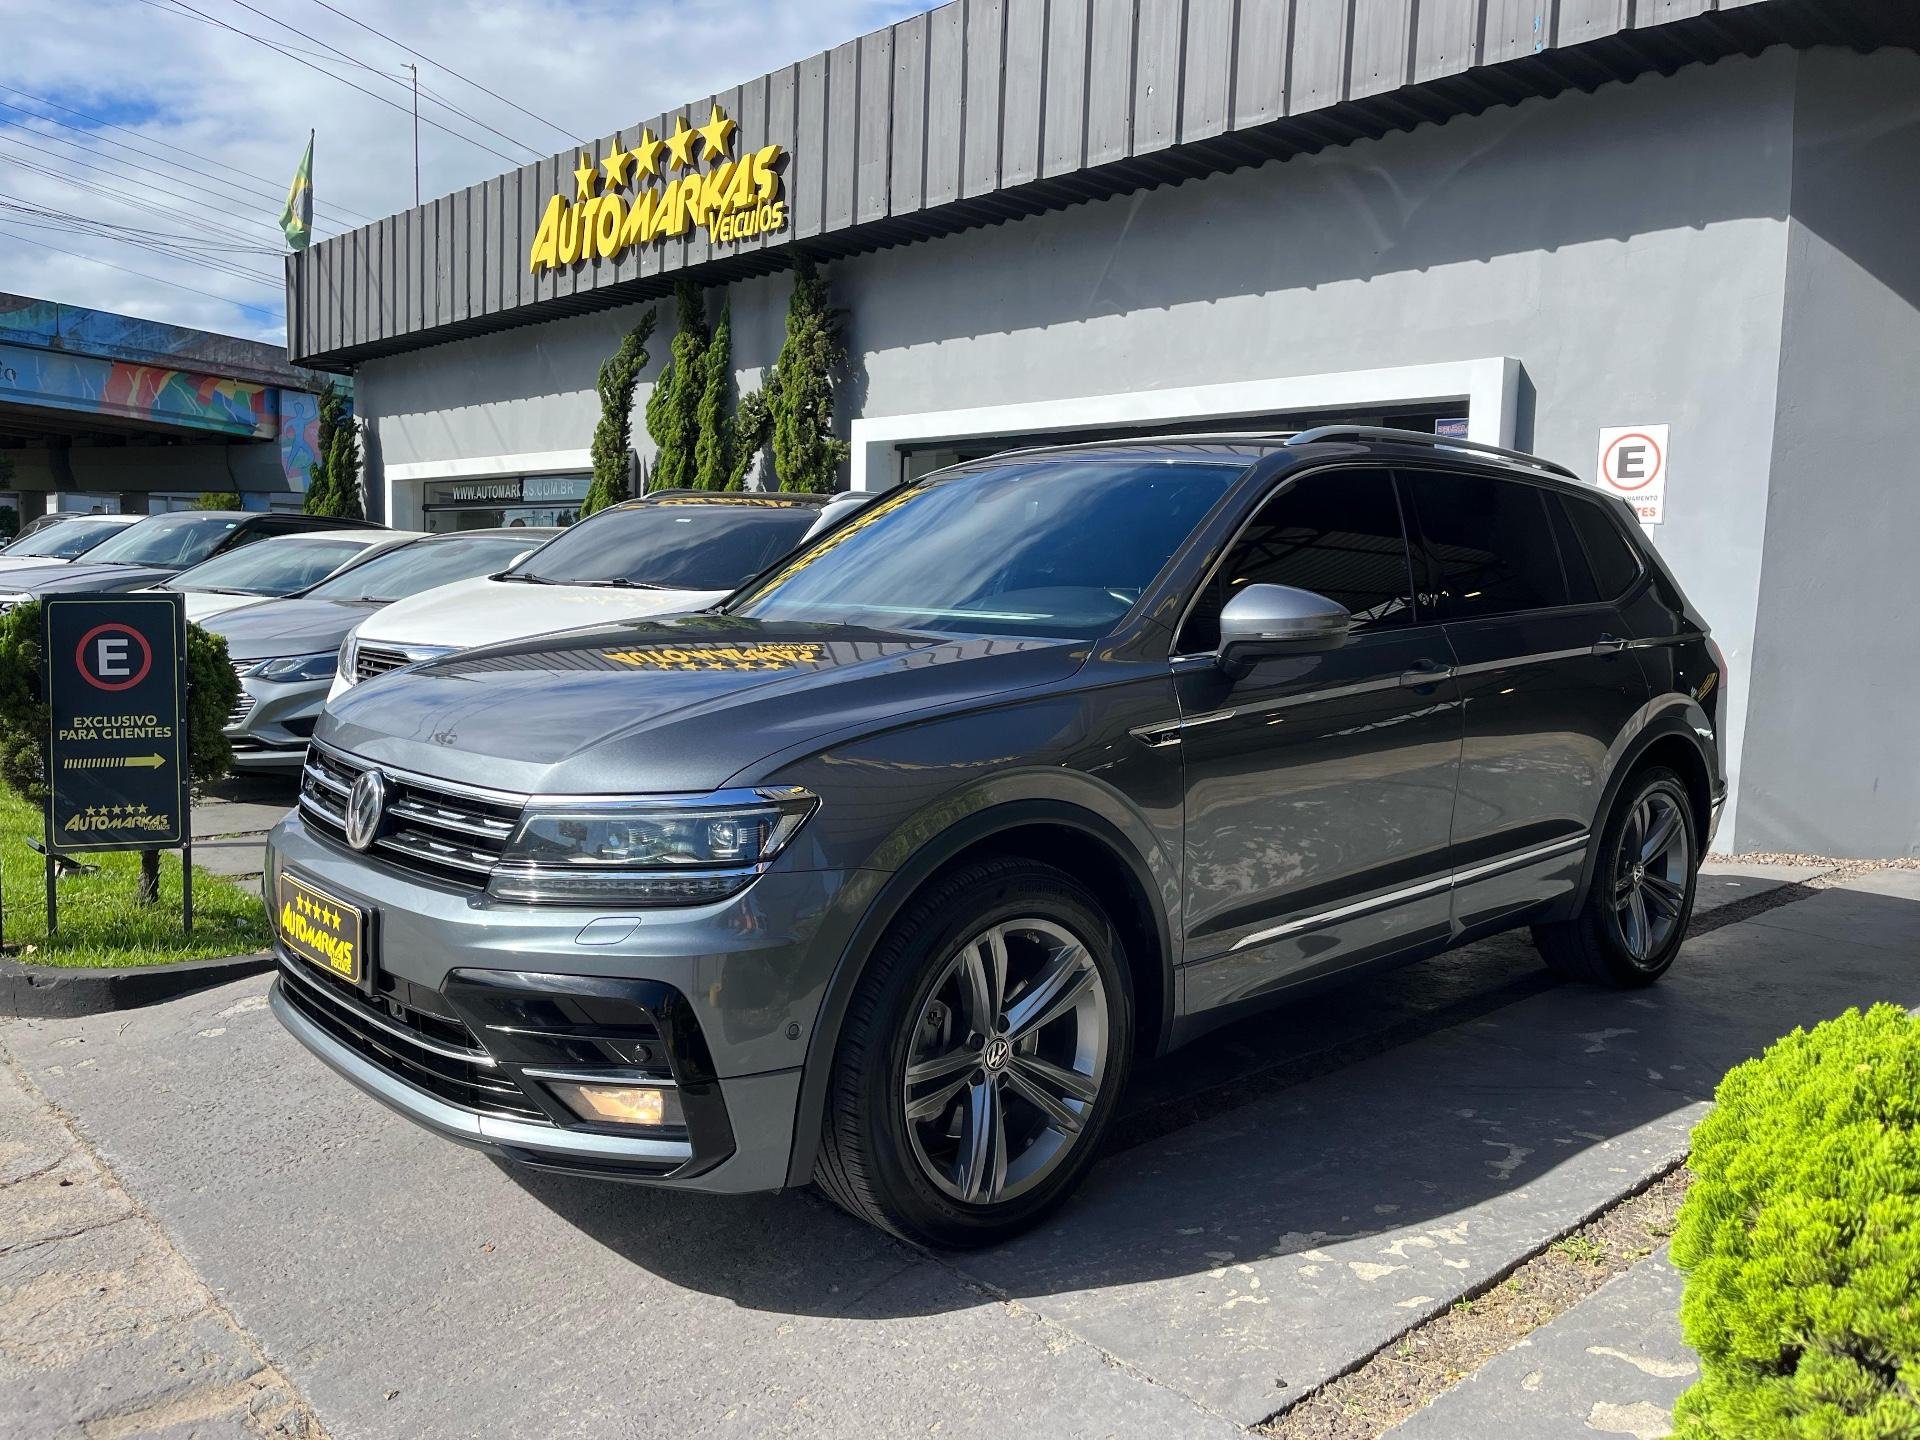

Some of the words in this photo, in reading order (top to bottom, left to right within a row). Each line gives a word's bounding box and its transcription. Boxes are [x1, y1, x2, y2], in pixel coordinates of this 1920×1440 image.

[530, 144, 782, 274] AUTOMARKAS
[1617, 445, 1646, 479] E
[453, 482, 574, 500] WWW.AUTOMARKAS.COM.BR
[97, 638, 130, 676] E
[60, 729, 99, 741] PARA
[102, 726, 172, 740] CLIENTES
[73, 714, 158, 728] EXCLUSIVO
[64, 813, 169, 832] AUTOMARKAS
[282, 901, 354, 966] AUTOMARKAS
